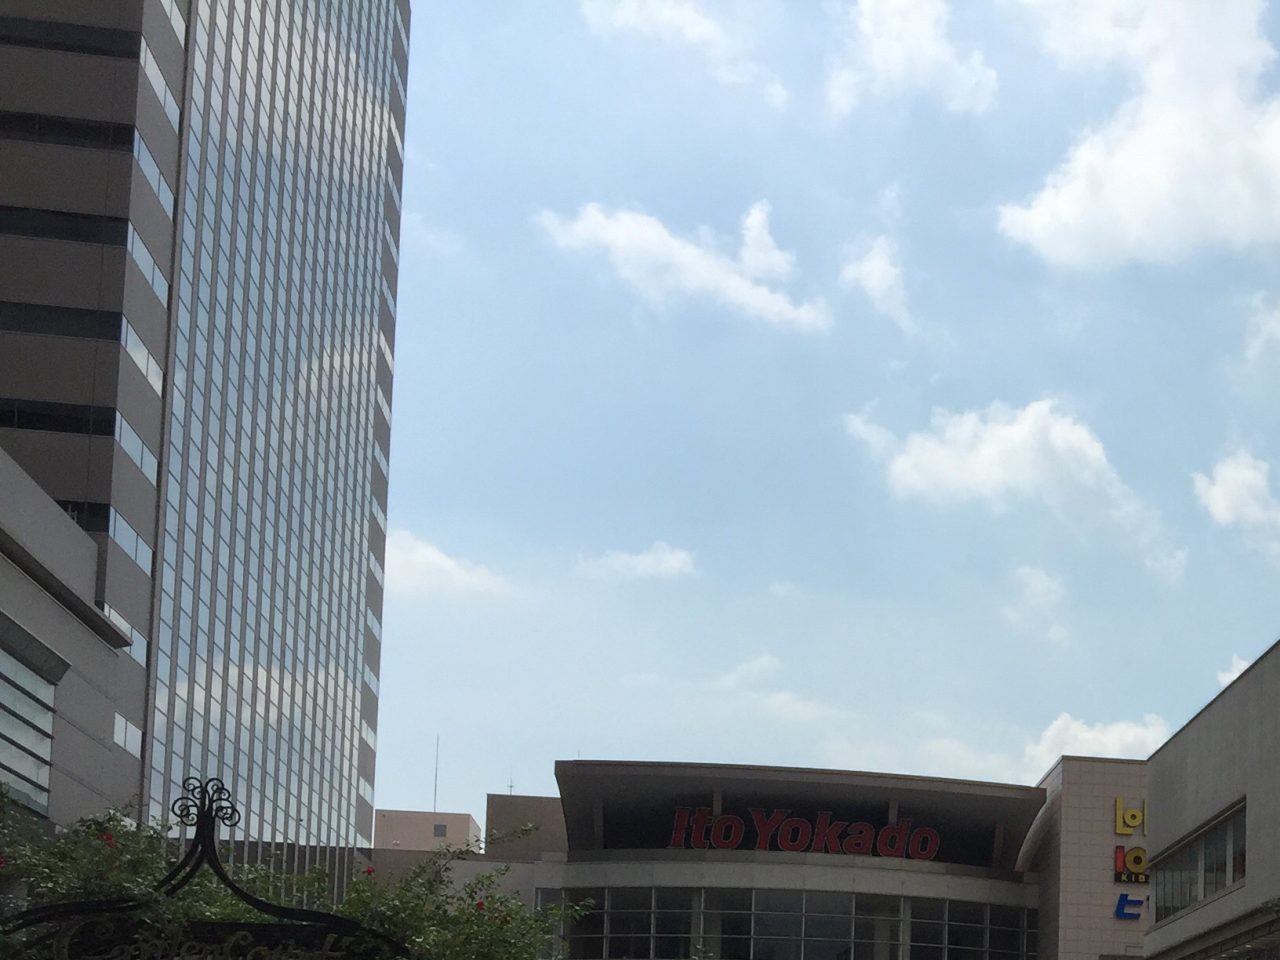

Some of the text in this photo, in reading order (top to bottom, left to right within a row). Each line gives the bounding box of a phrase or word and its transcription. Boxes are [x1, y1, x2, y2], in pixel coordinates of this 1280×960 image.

[668, 806, 941, 861] Ito Yokado
[1120, 873, 1147, 883] KIB
